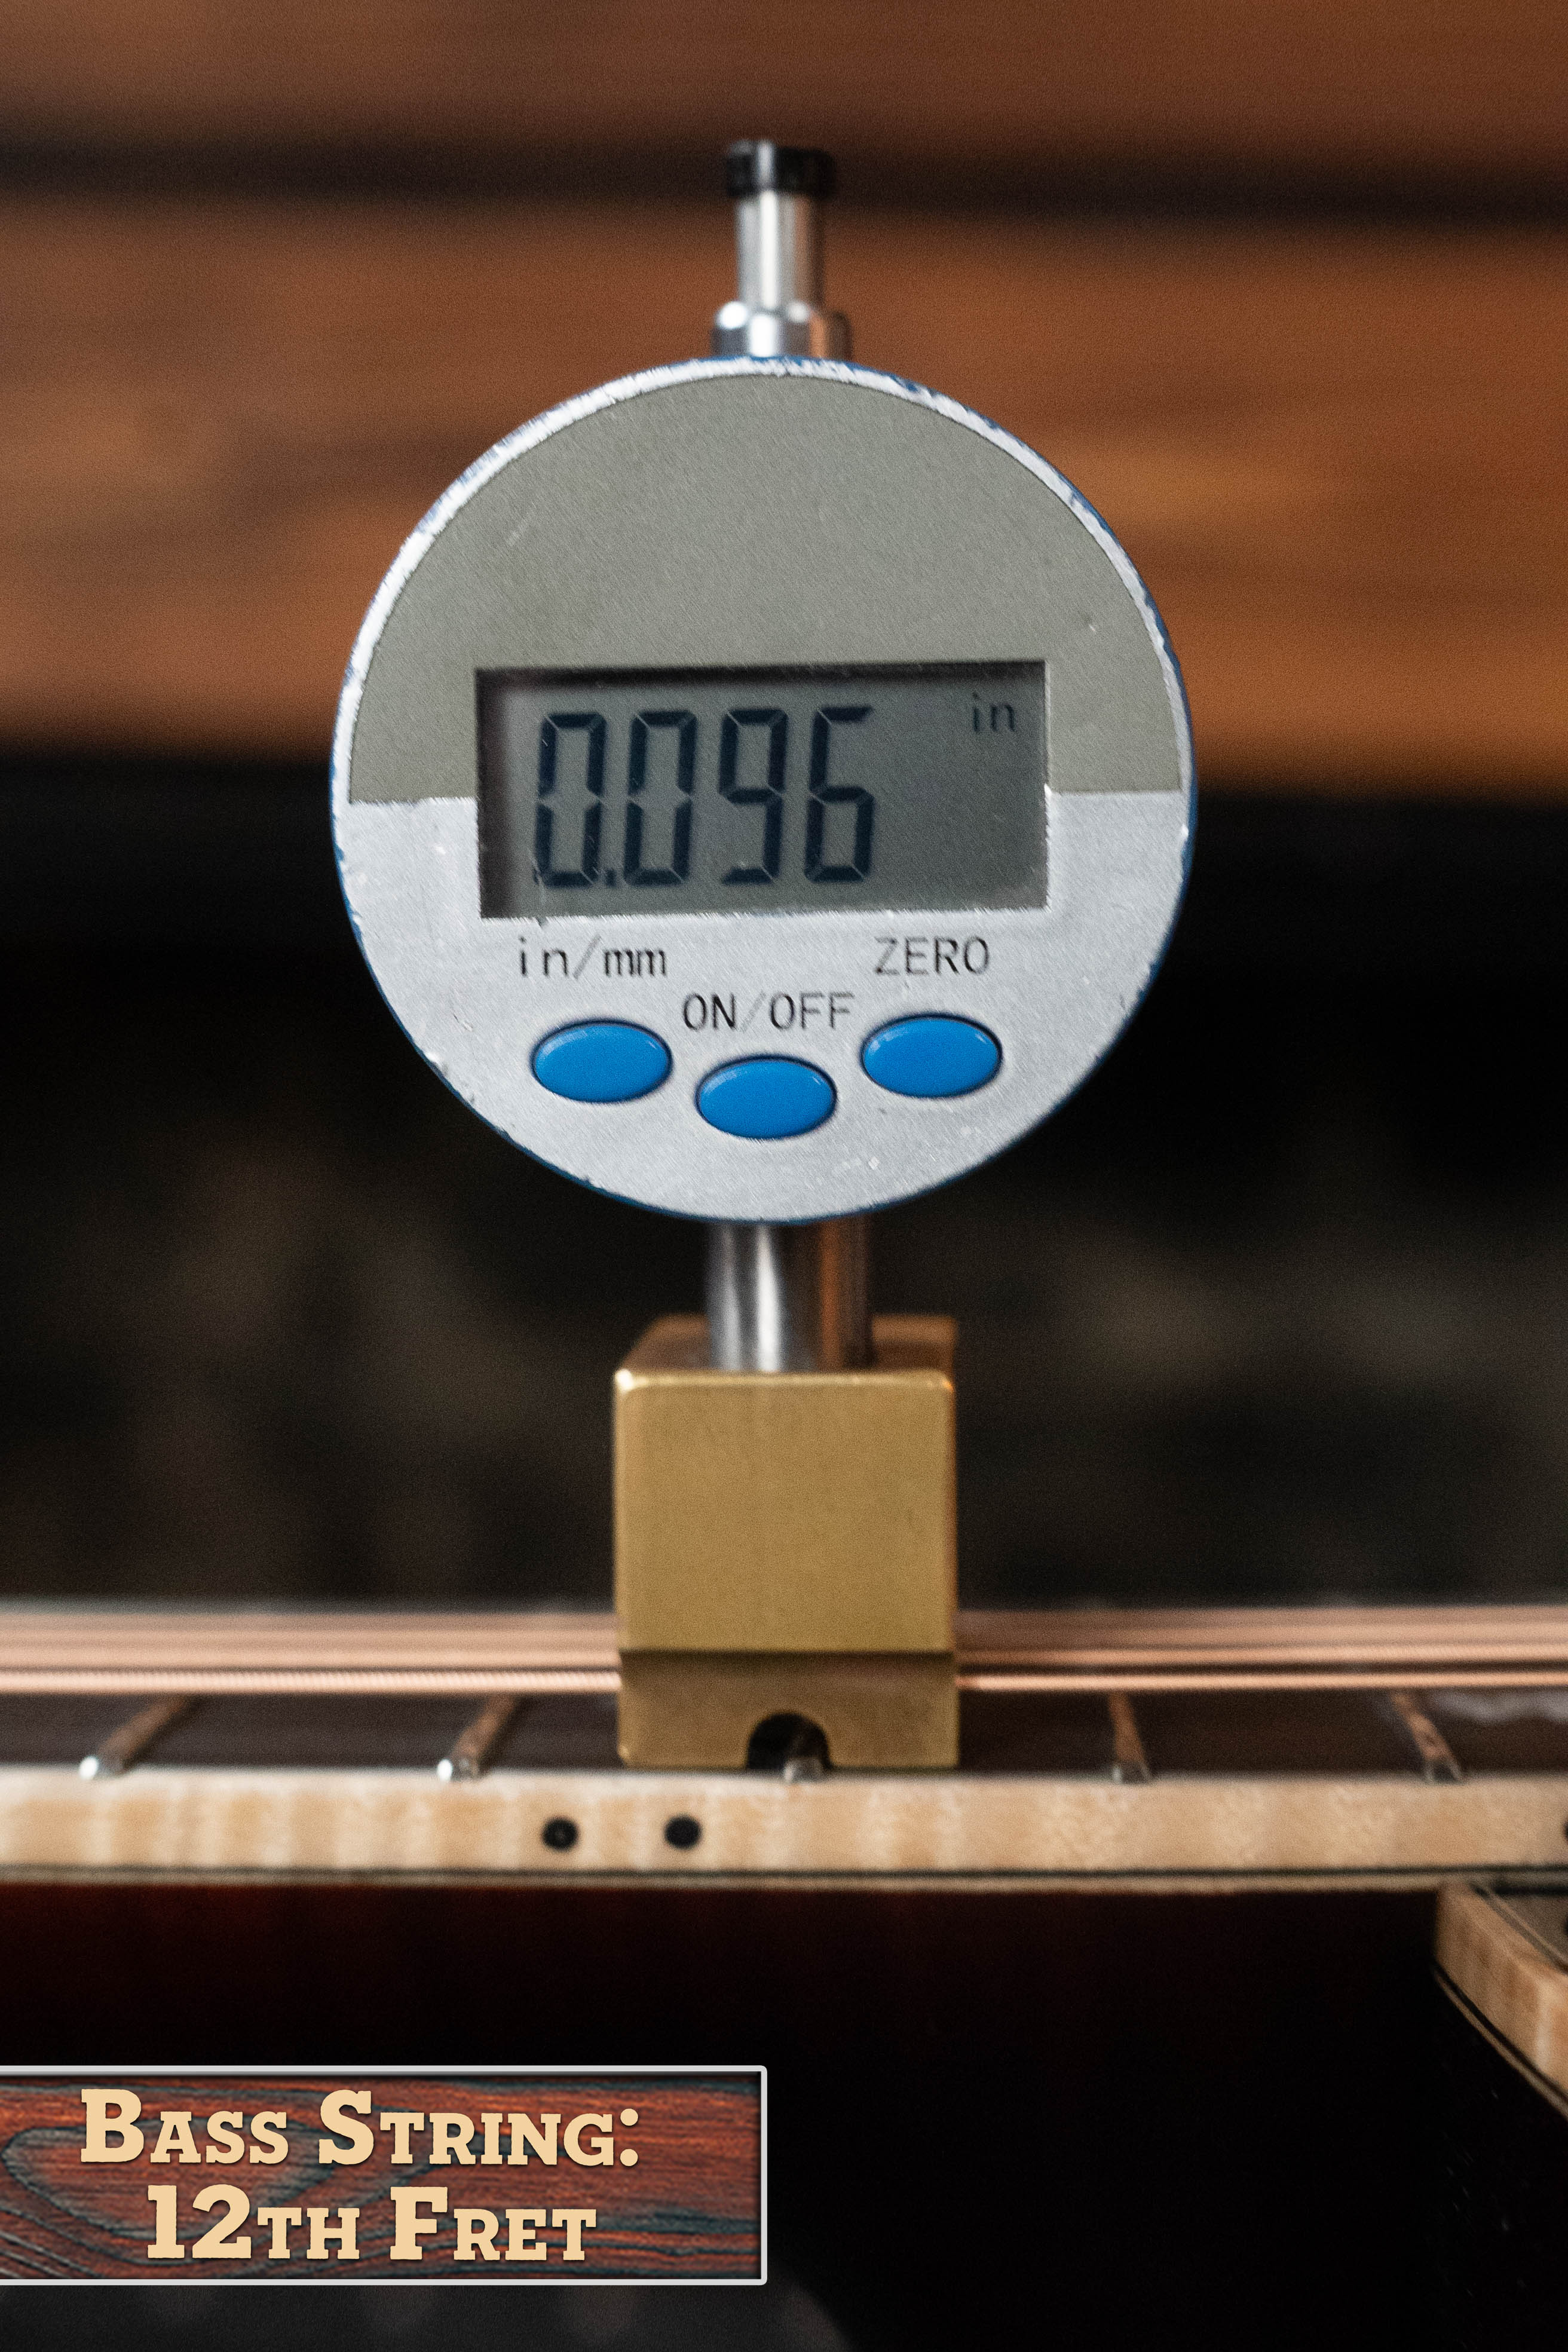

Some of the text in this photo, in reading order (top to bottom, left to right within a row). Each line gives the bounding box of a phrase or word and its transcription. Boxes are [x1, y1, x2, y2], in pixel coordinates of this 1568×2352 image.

[972, 692, 1015, 734] in
[535, 706, 875, 888] 0.096
[518, 936, 668, 980] in/mm
[874, 936, 990, 975] ZERO
[682, 992, 855, 1032] ON/OFF
